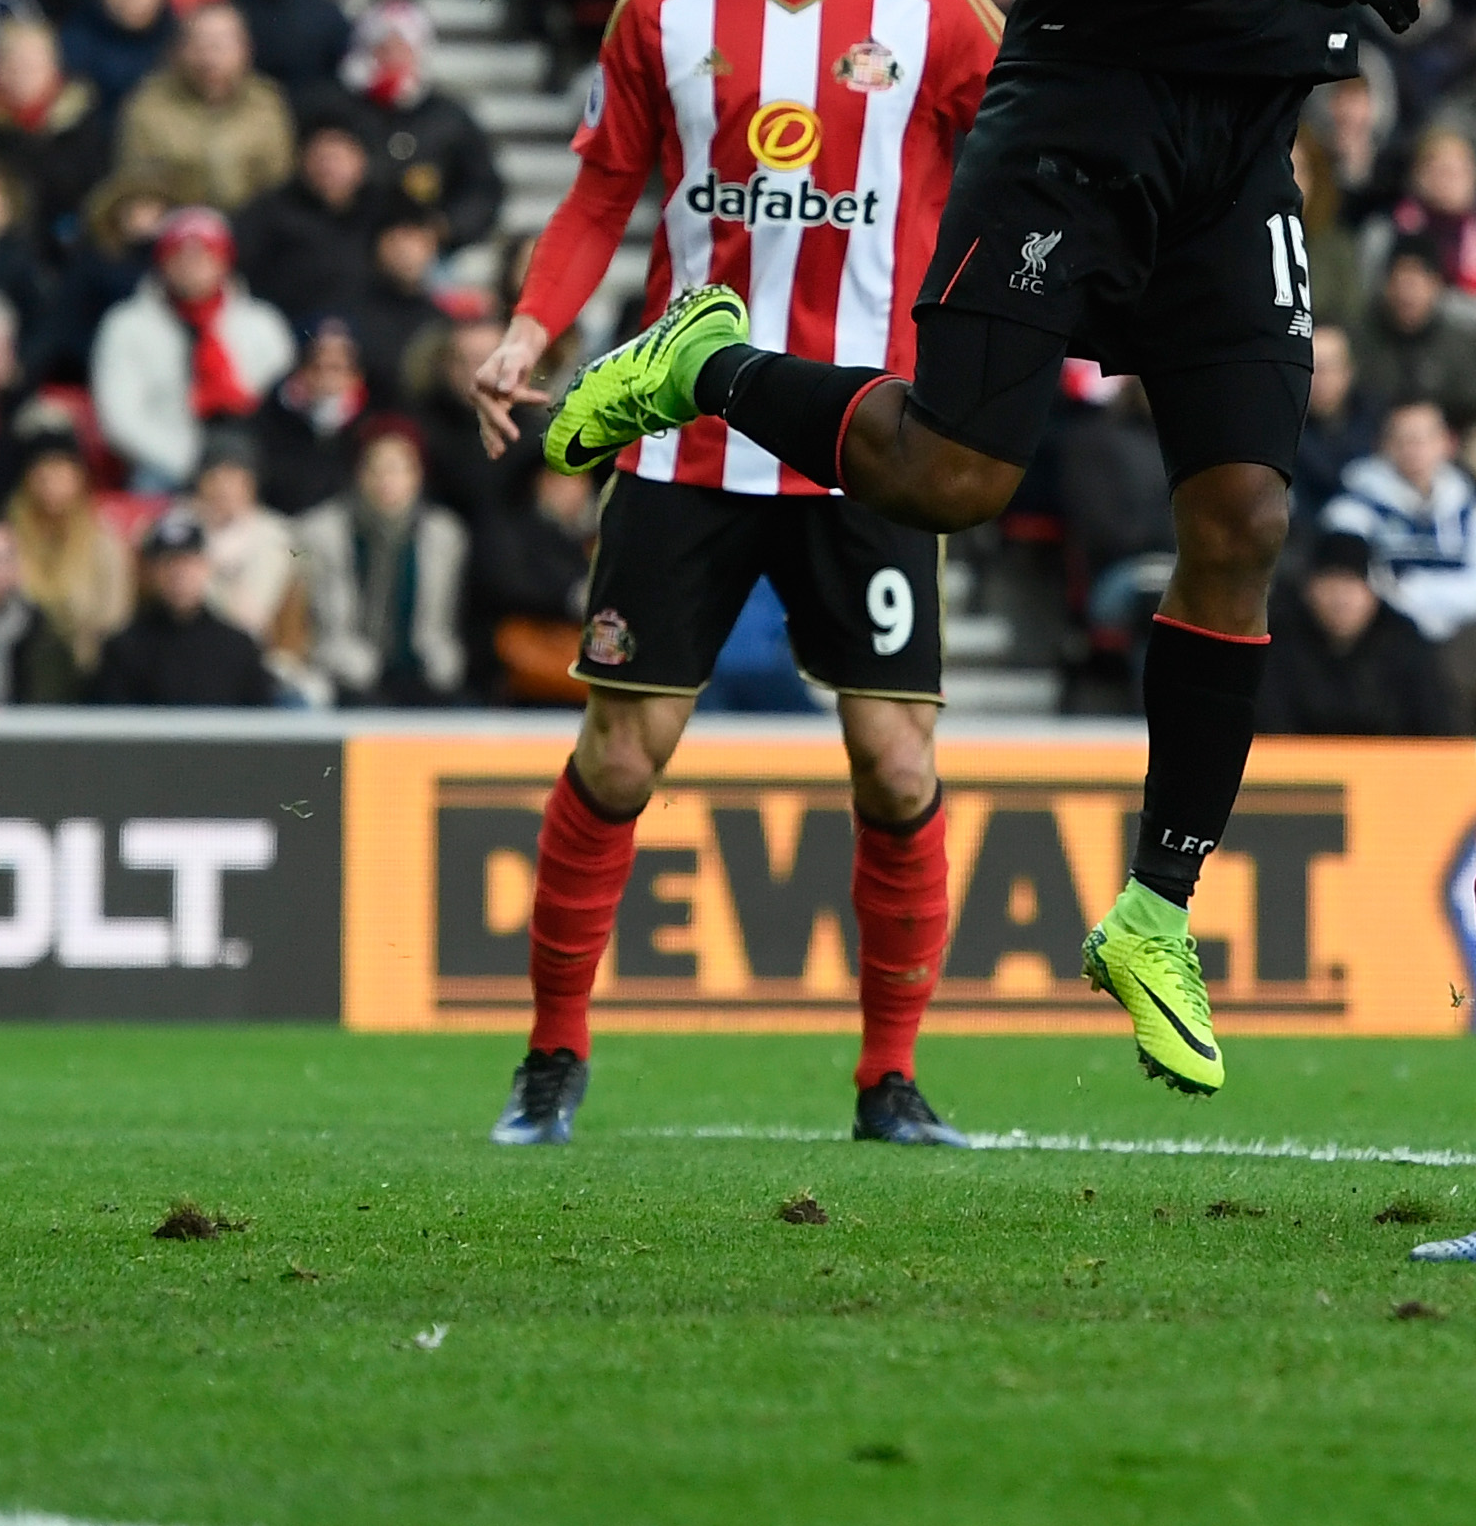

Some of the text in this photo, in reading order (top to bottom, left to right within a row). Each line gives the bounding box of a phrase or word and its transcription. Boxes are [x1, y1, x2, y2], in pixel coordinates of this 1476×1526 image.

[687, 170, 879, 226] dafabet
[865, 566, 915, 657] 9
[438, 806, 1345, 981] DEWAT
